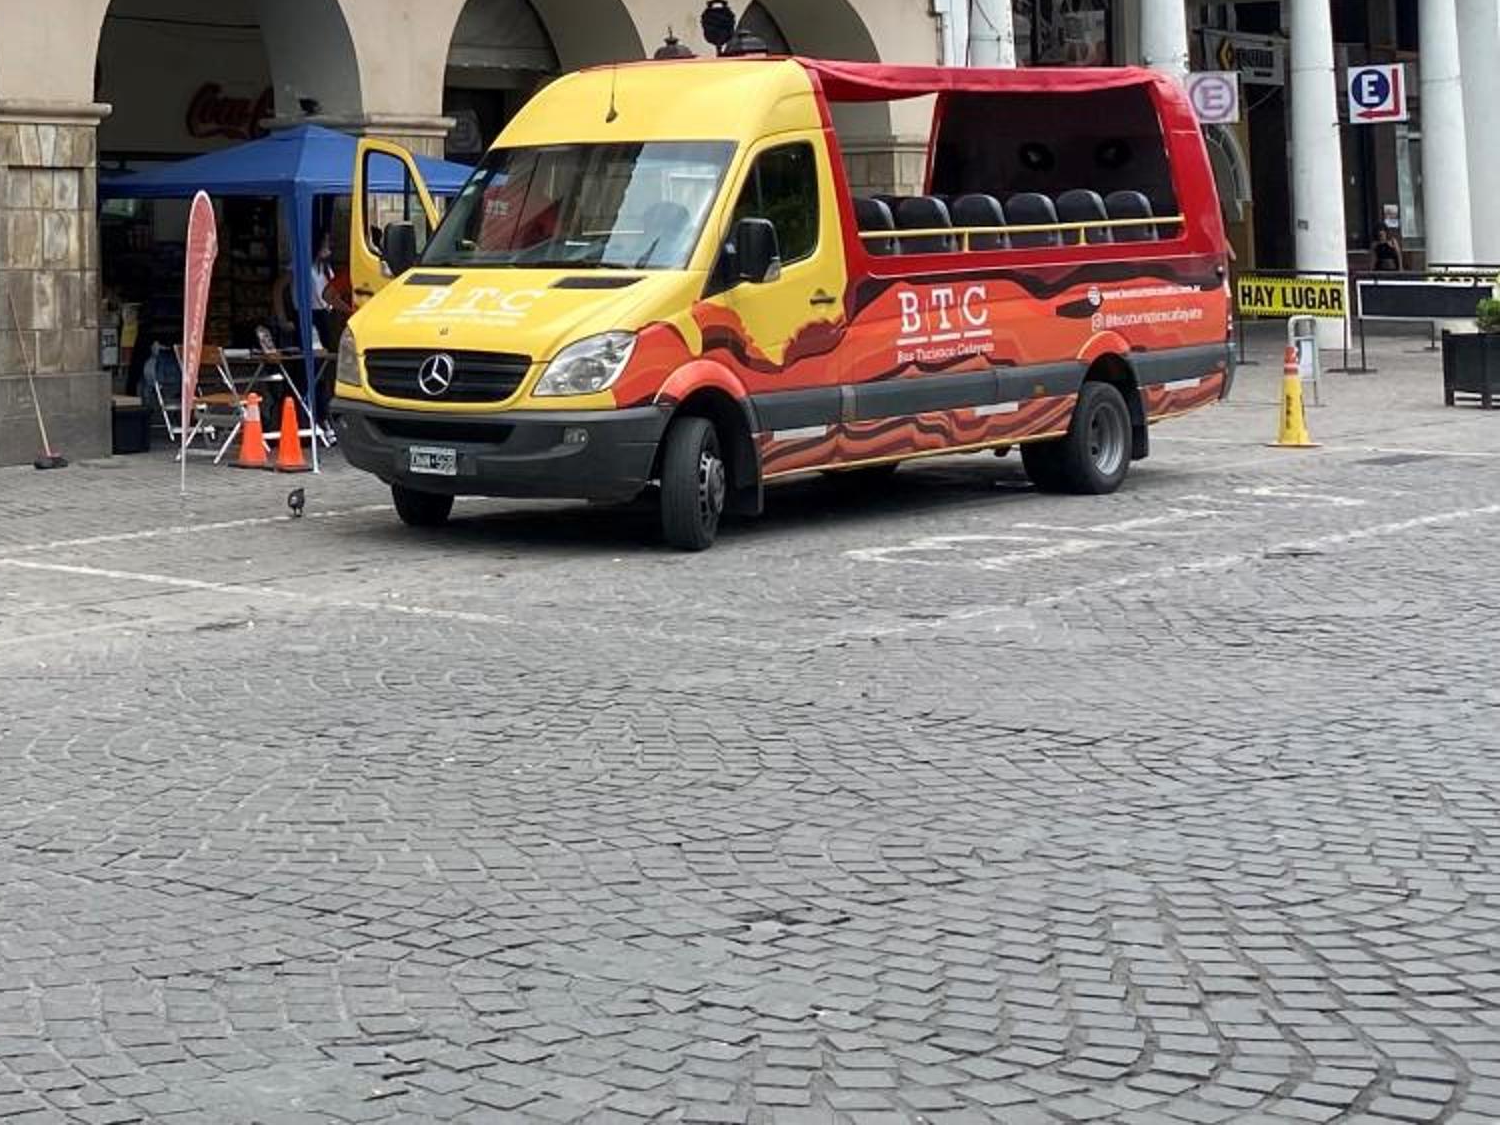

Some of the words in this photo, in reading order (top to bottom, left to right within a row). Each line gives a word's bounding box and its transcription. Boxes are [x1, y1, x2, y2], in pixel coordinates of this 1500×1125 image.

[1201, 84, 1225, 112] E
[1361, 73, 1380, 105] E
[897, 285, 989, 334] BTC
[1241, 285, 1280, 308] HAY
[1281, 286, 1343, 311] LUGAR
